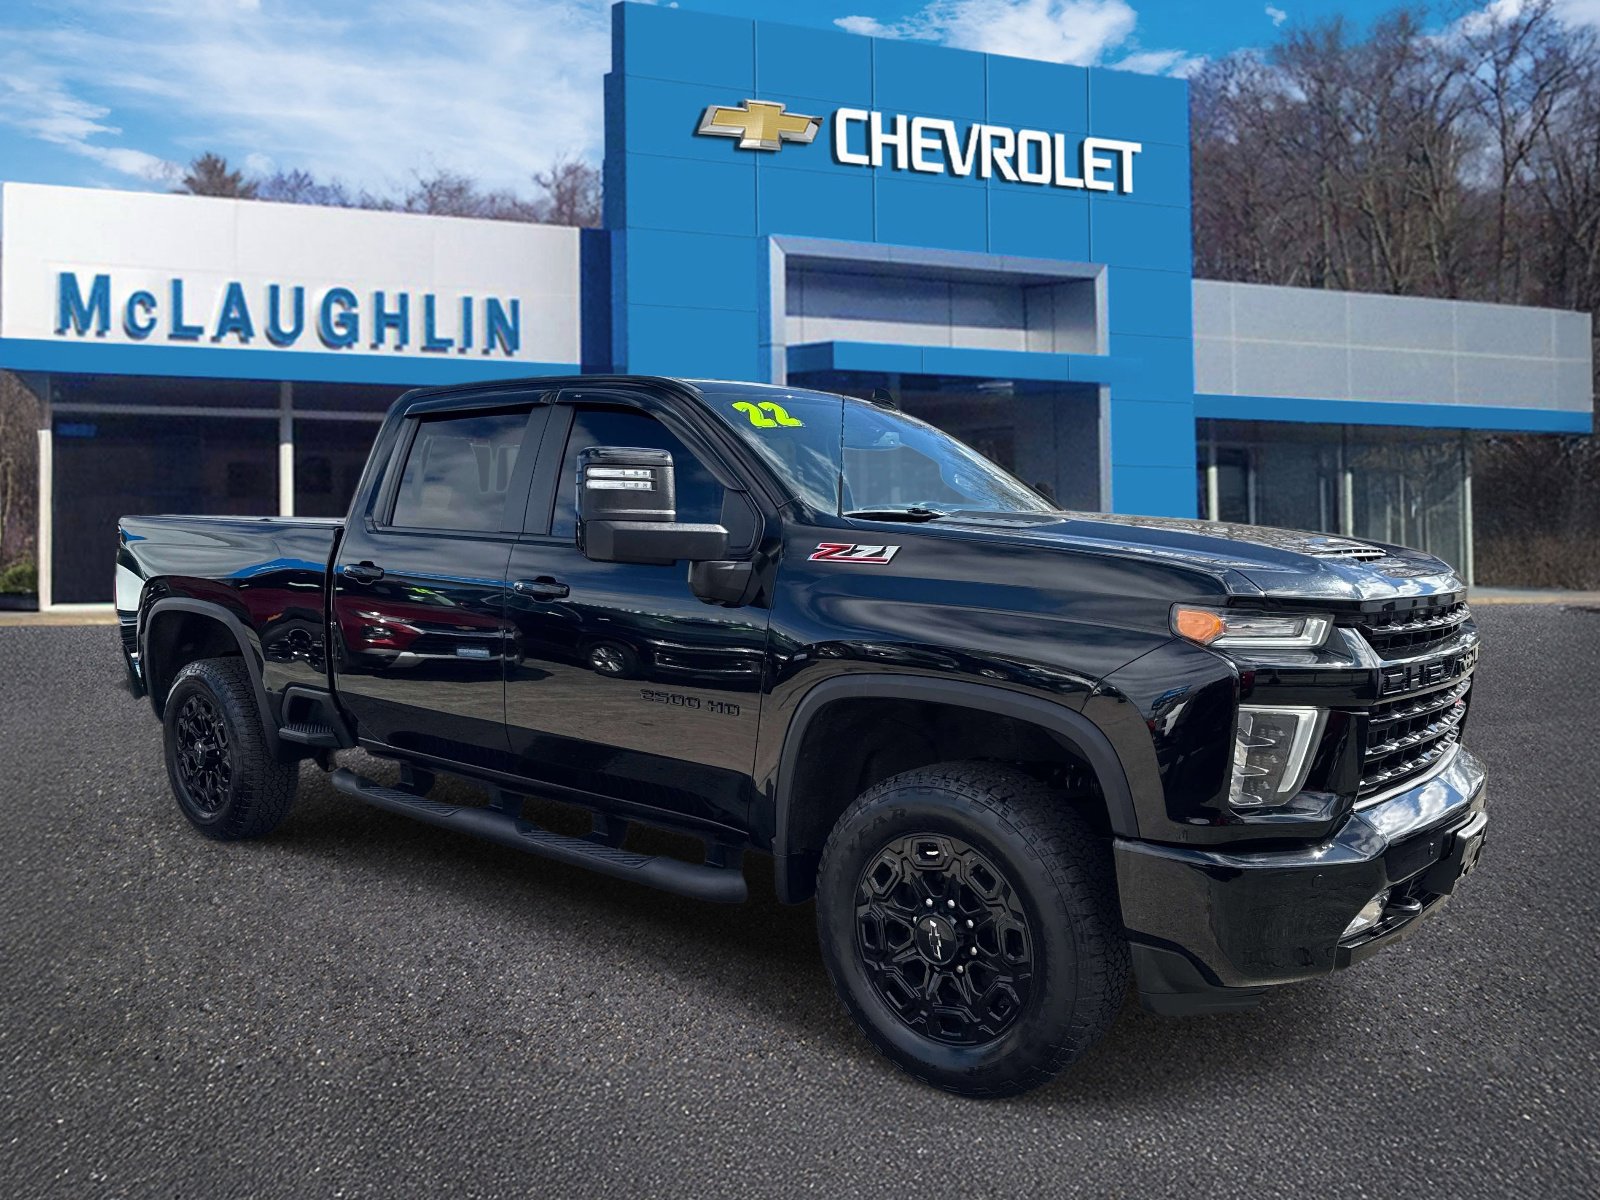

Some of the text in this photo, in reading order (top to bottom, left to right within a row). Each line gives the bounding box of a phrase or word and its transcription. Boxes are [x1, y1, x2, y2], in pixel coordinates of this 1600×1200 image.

[835, 107, 1142, 194] CHEVROLET
[732, 401, 803, 429] 22
[807, 542, 902, 565] Z71
[707, 700, 740, 717] HD
